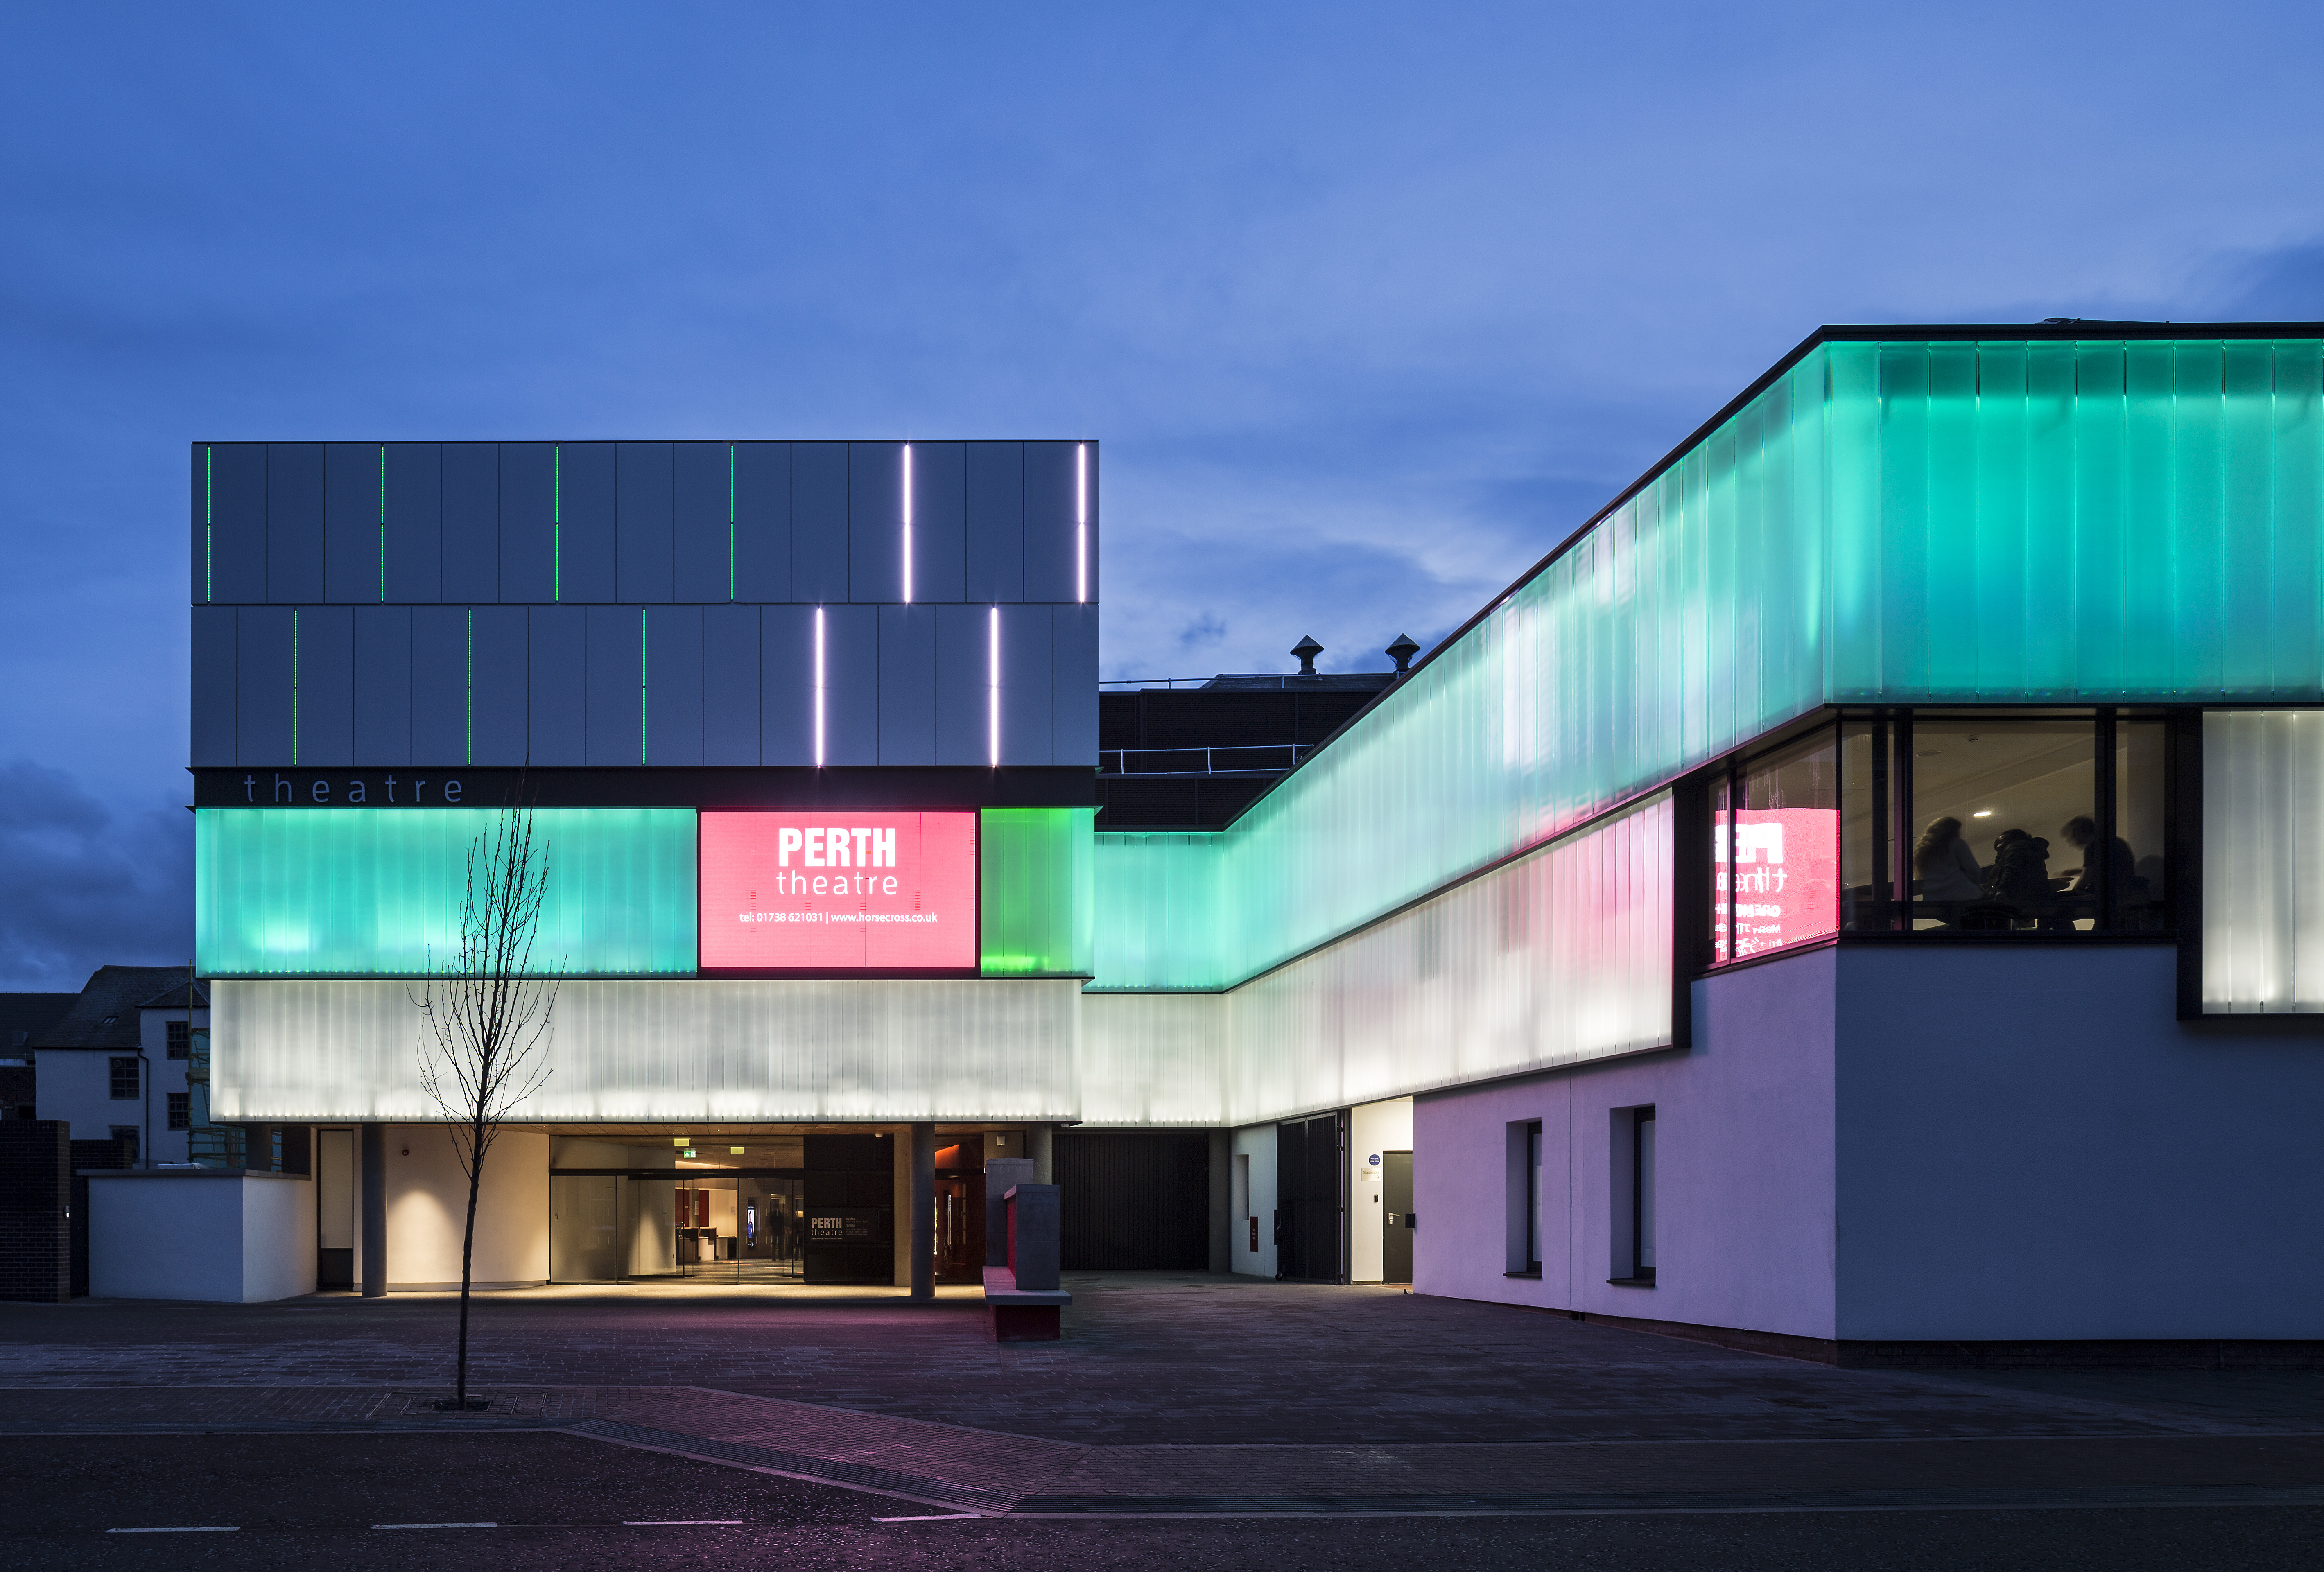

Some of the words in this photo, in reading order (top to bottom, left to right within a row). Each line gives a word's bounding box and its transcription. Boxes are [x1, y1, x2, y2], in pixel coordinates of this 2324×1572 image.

[244, 773, 462, 802] theatre
[779, 828, 895, 867] PERTH
[776, 870, 897, 895] theatre
[739, 912, 755, 922] tel:
[756, 912, 786, 922] 01738
[788, 912, 822, 922] 621031
[831, 912, 938, 922] www.horsecross.co.uk
[812, 1218, 842, 1228] PERTH
